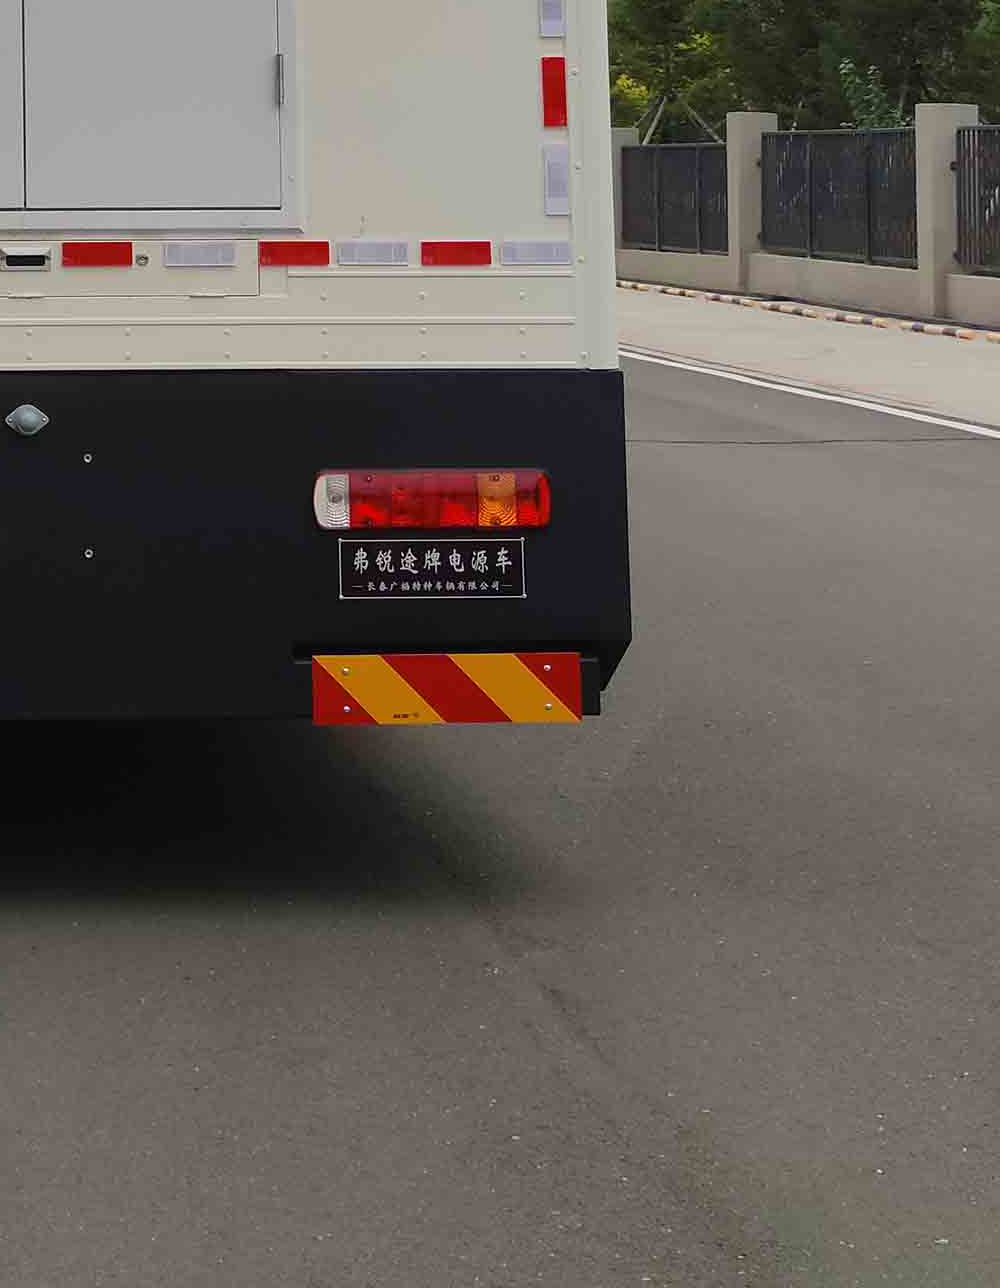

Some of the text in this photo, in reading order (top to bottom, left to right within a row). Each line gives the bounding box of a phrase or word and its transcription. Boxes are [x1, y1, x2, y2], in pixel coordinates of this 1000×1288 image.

[353, 547, 513, 575] 弗锐途牌电源车
